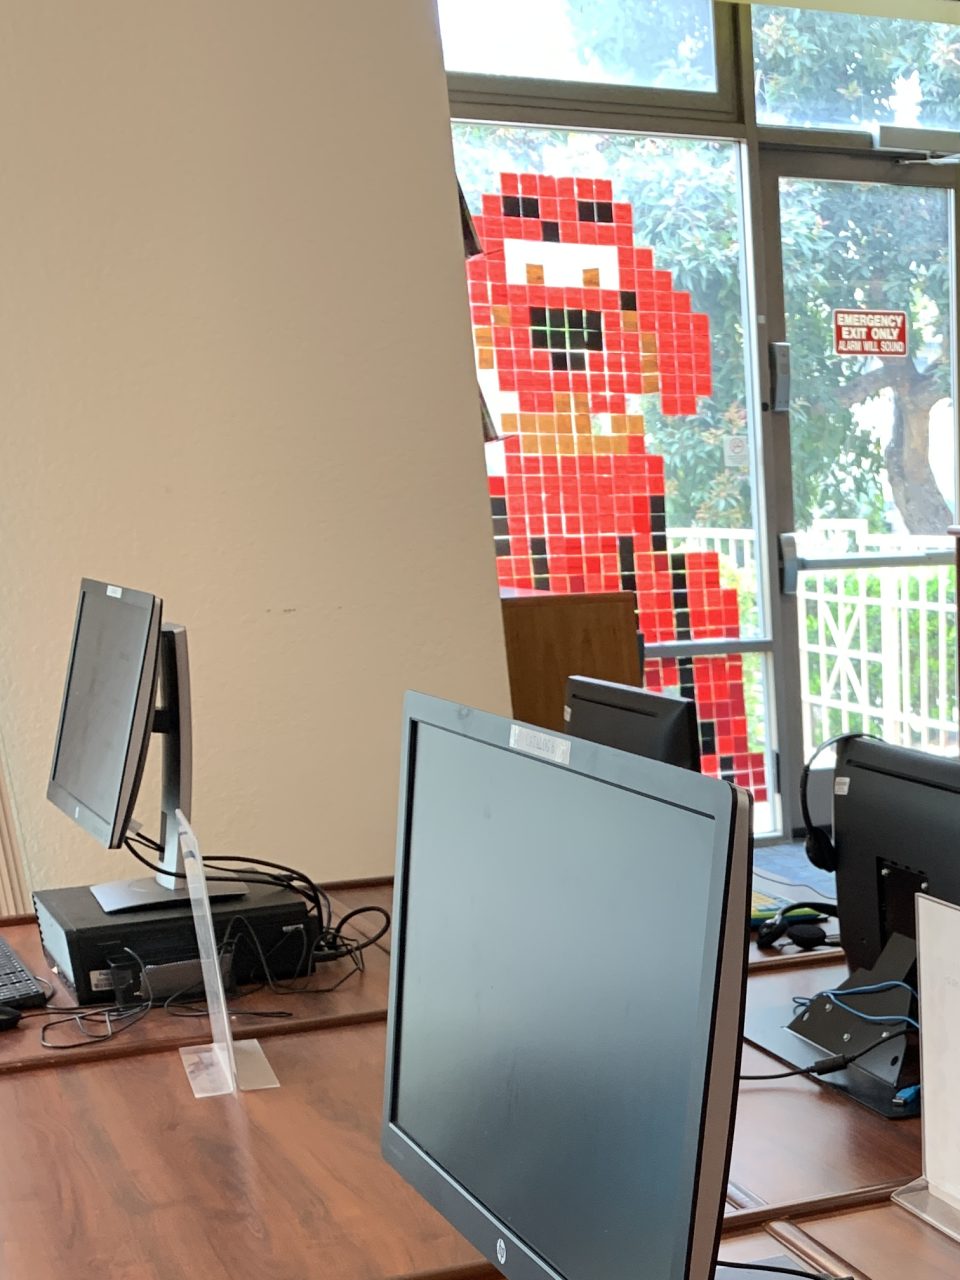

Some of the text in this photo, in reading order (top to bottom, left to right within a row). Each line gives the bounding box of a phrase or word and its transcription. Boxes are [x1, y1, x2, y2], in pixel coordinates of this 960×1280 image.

[837, 313, 904, 328] EMERGENCY
[841, 326, 900, 340] EXIT ONLY
[838, 340, 904, 352] ALARM WILL SOUND
